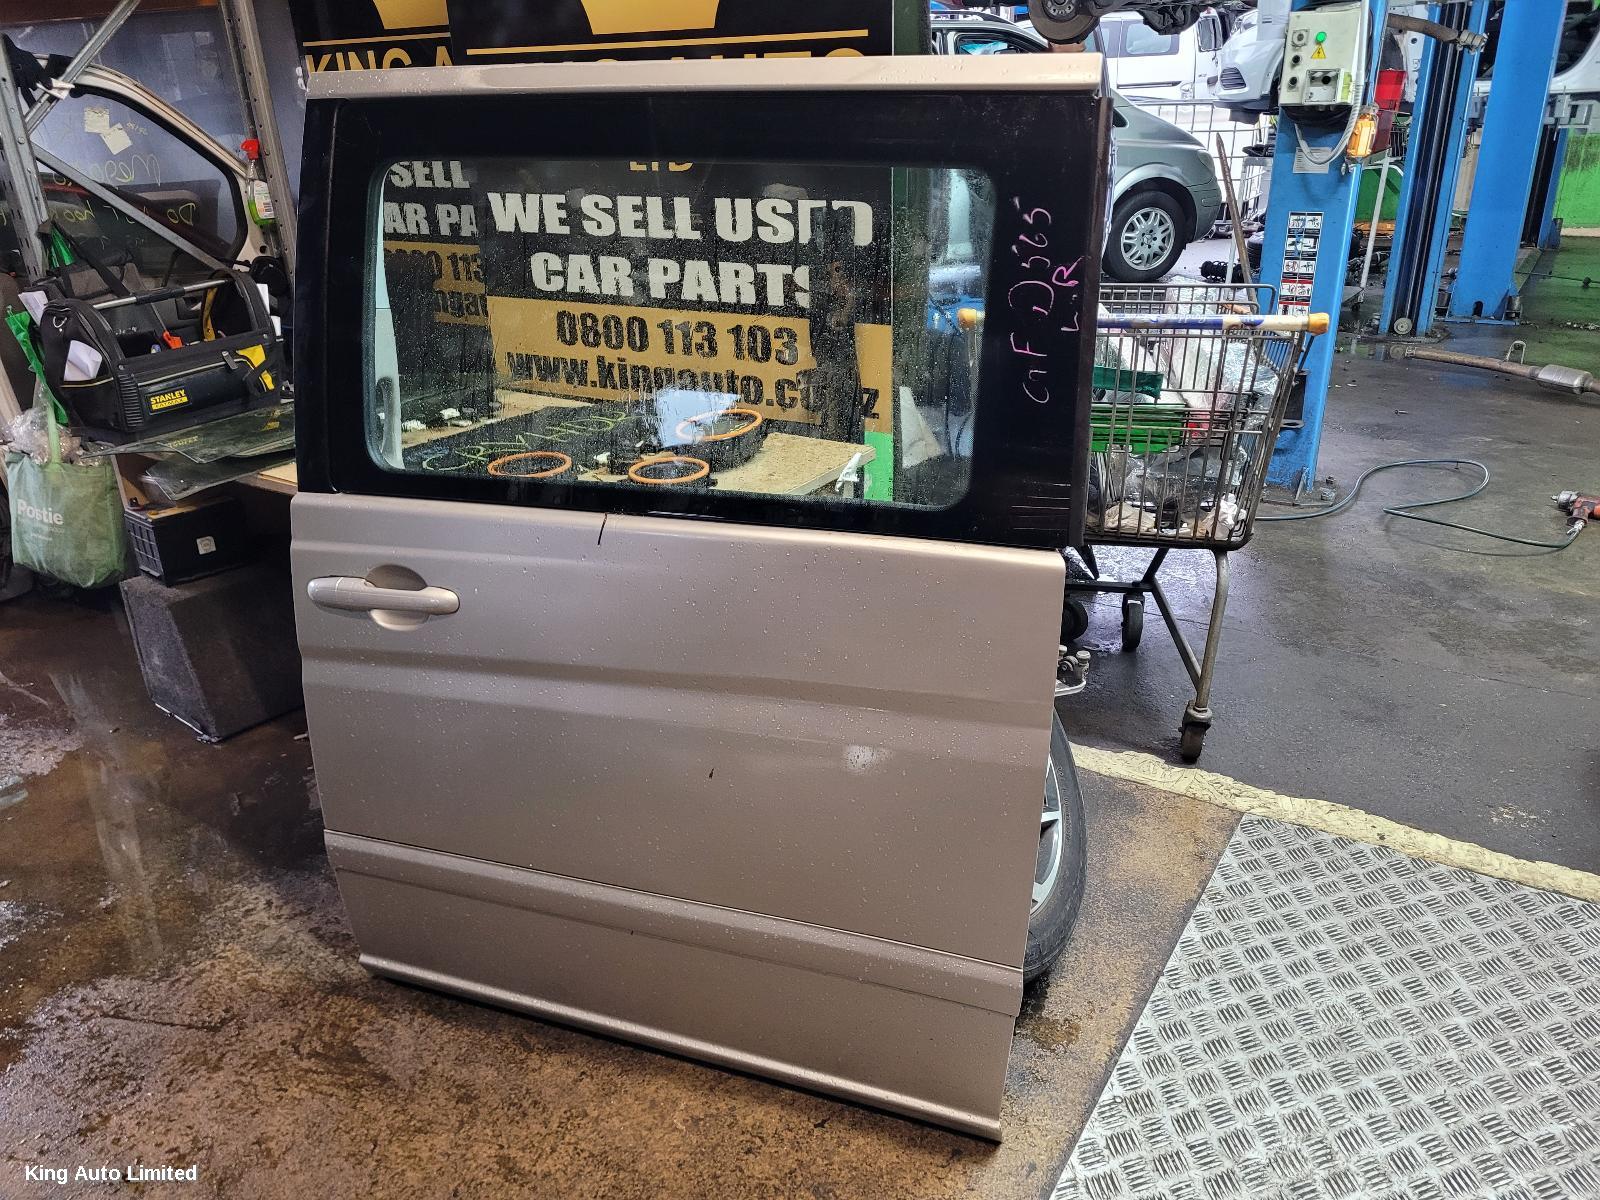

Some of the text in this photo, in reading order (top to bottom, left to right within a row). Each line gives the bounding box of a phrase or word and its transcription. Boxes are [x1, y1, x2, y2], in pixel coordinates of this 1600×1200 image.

[389, 160, 471, 189] SELL
[487, 192, 571, 235] WE
[580, 194, 701, 240] SELL
[530, 251, 634, 298] CAR
[556, 310, 799, 366] 0800 113 103
[150, 389, 186, 405] STANLEY
[505, 352, 881, 420] www.kingauto.coz
